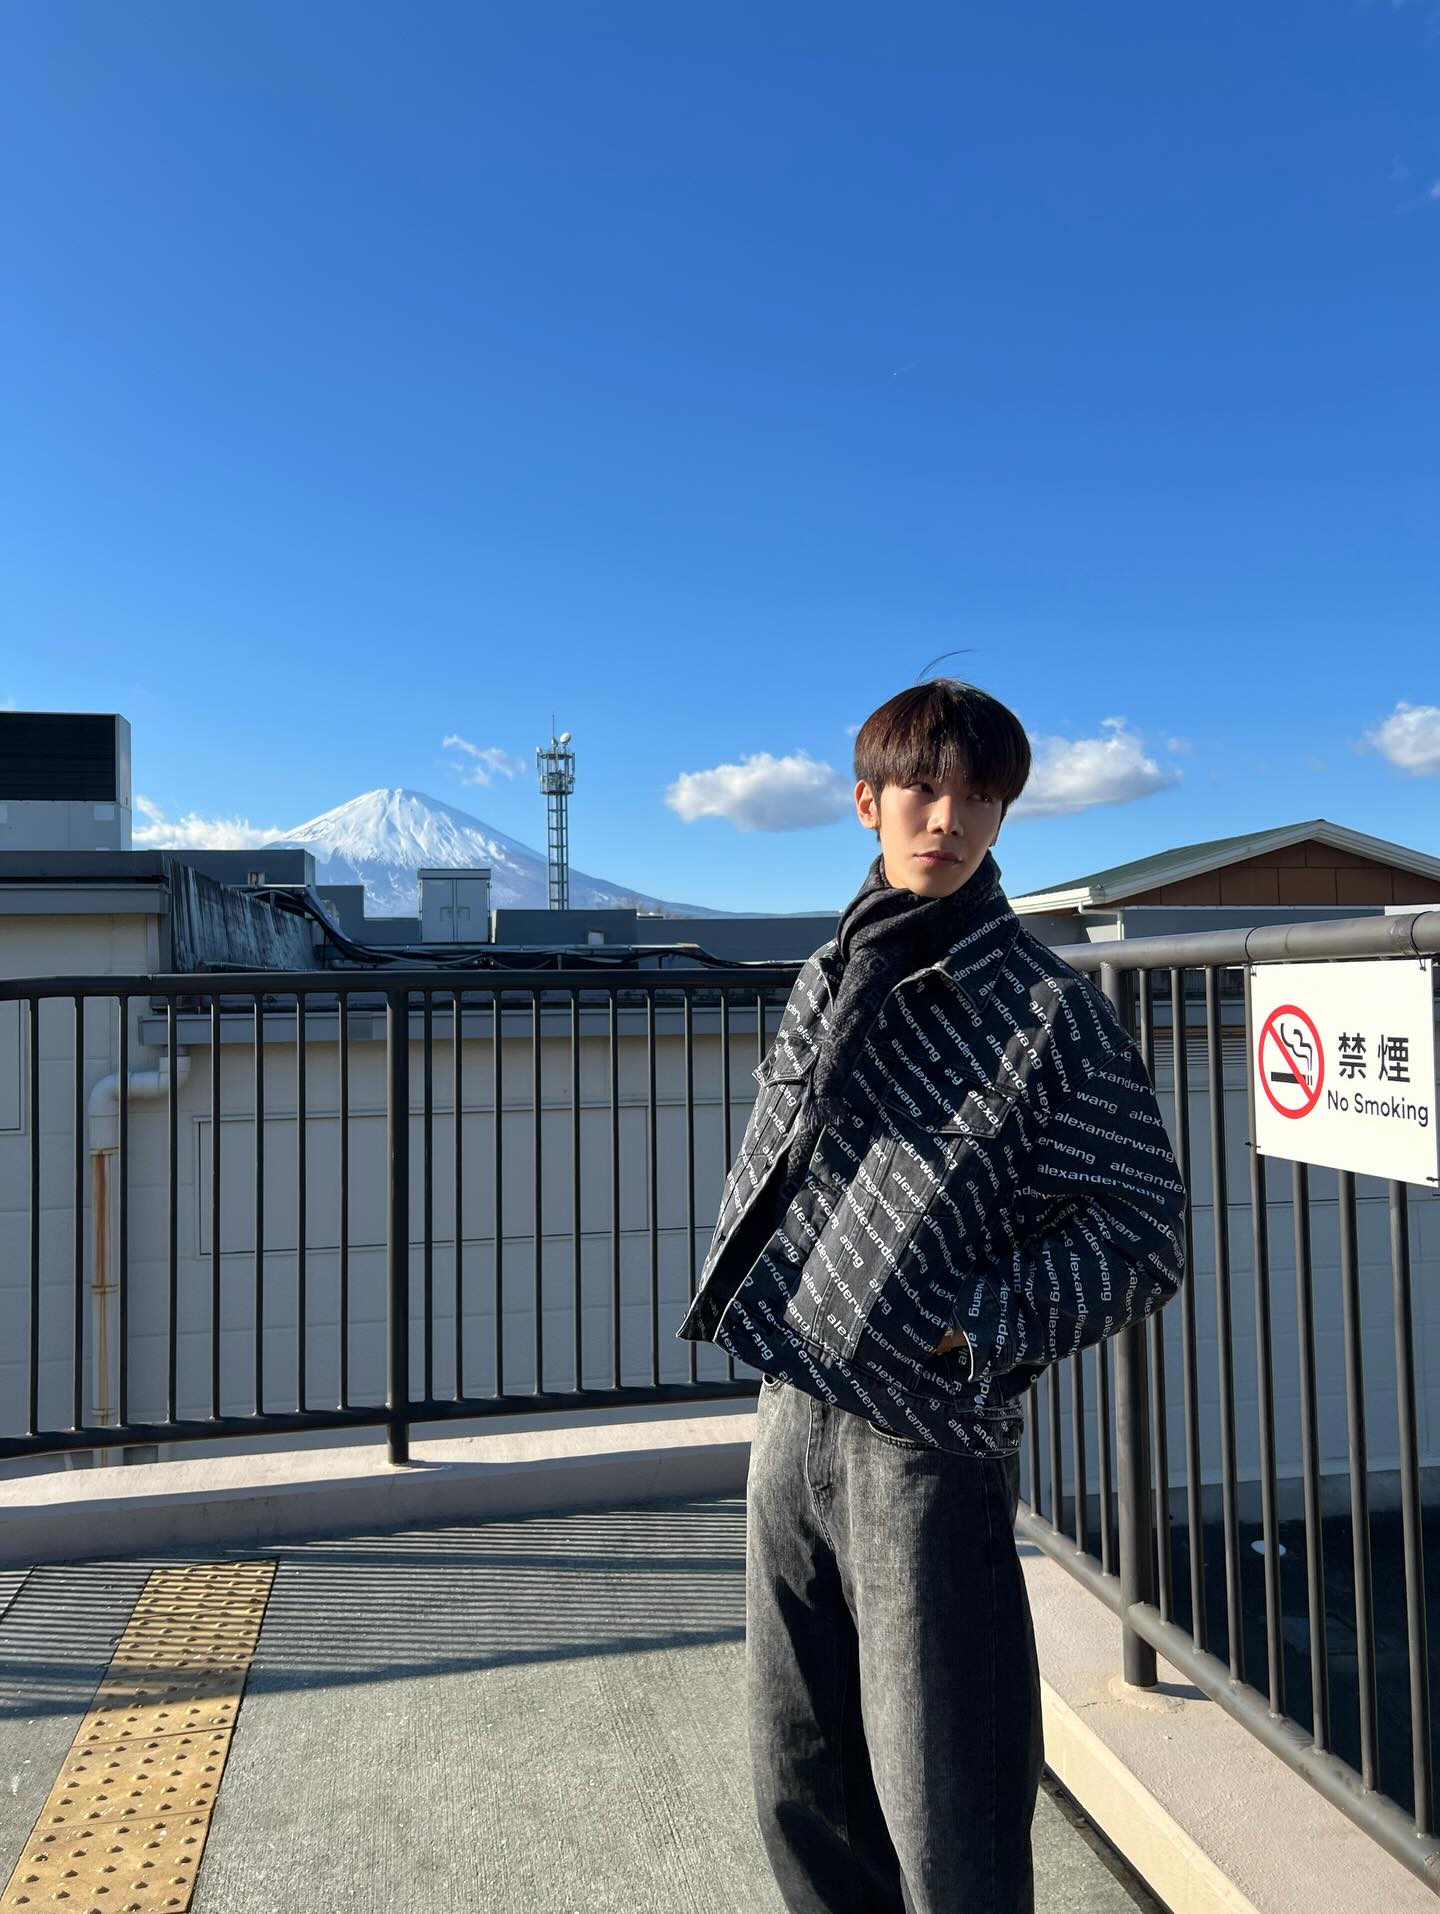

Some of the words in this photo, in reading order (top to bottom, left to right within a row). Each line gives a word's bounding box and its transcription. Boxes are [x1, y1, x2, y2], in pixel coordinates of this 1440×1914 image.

[1338, 1032, 1411, 1083] 禁煙
[1076, 1091, 1119, 1115] wang
[1328, 1090, 1349, 1111] No
[1354, 1093, 1429, 1127] Smoking
[1038, 1136, 1096, 1165] erwang
[1054, 1112, 1176, 1163] alexanderwang
[1037, 1164, 1166, 1206] alexanderwang
